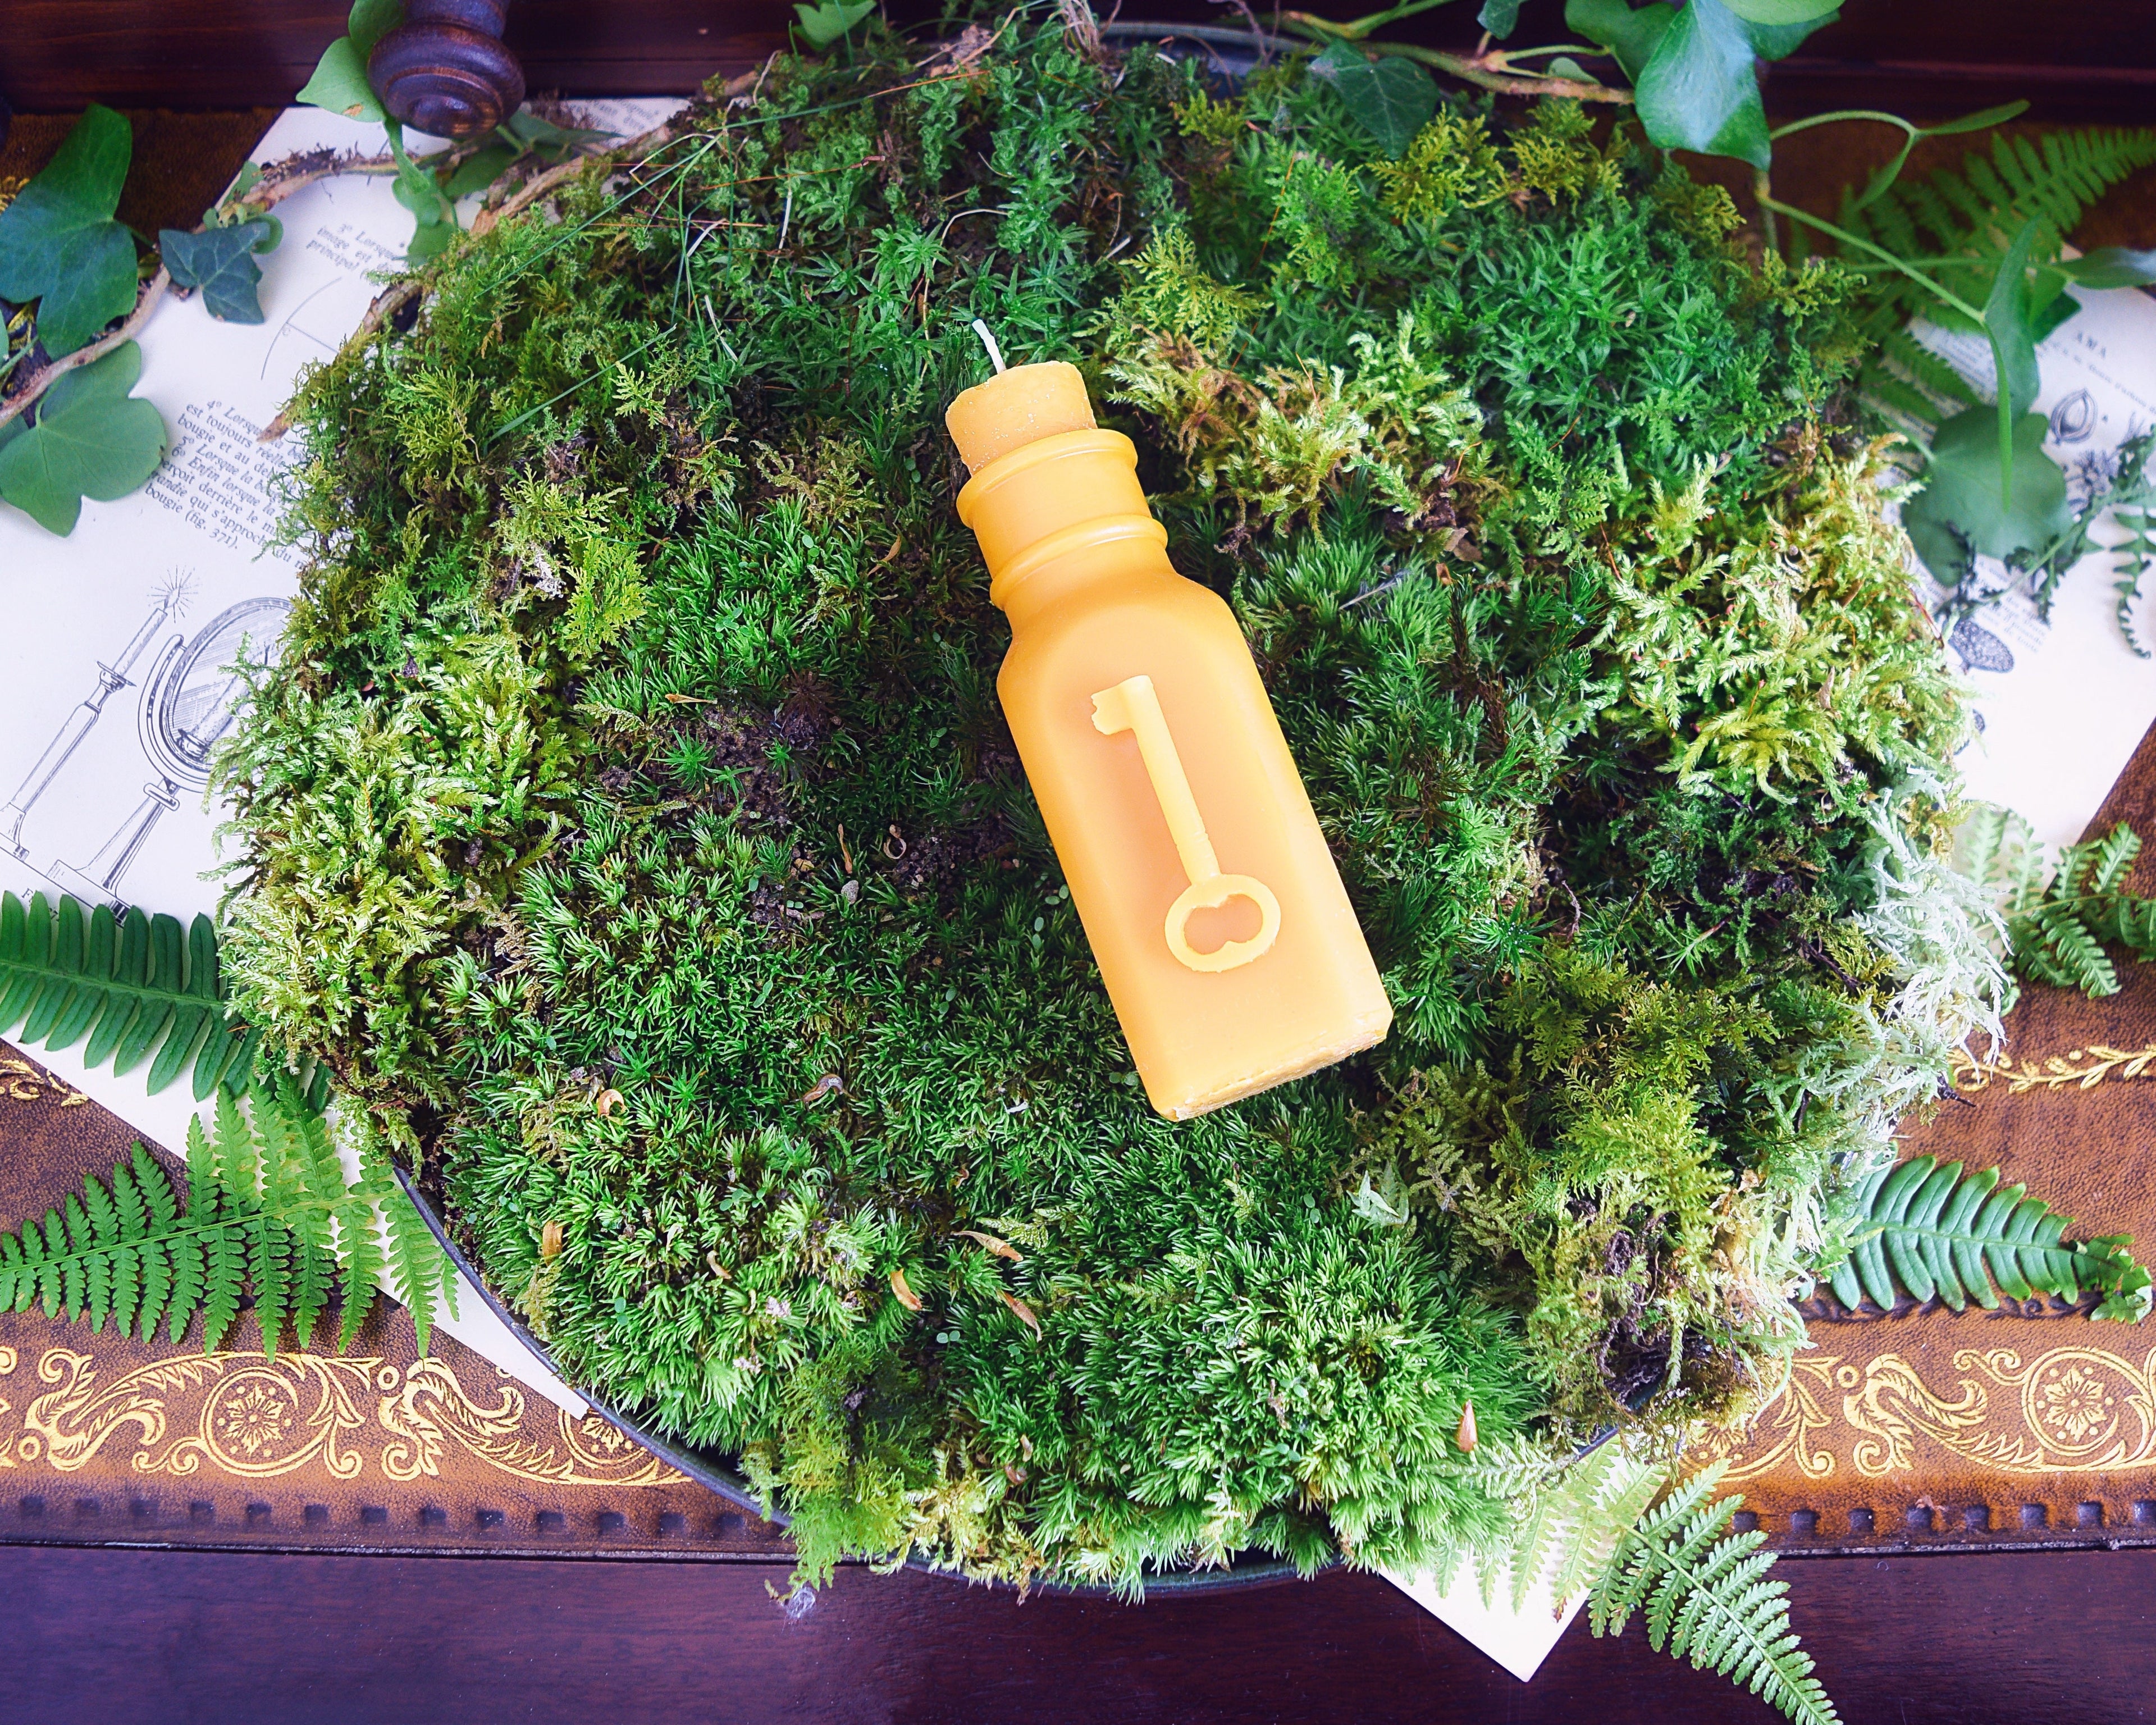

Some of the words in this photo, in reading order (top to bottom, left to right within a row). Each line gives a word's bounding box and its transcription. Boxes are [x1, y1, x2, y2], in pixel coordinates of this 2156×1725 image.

[177, 413, 215, 442] bougie
[220, 442, 232, 453] et
[235, 451, 249, 464] au
[186, 404, 203, 418] est
[207, 415, 252, 448] toujours
[224, 407, 263, 436] Lorsqu
[188, 456, 220, 482] Enfin
[222, 477, 260, 506] lorsque
[263, 502, 275, 516] la
[196, 444, 239, 475] Lorsque
[240, 471, 253, 484] la
[145, 483, 182, 513] bougie
[185, 509, 207, 530] (fig.
[209, 528, 237, 549] 371).
[199, 482, 243, 514] derrière
[246, 510, 258, 523] le
[190, 495, 208, 513] qui
[212, 507, 266, 546] s'approch
[276, 547, 291, 562] du
